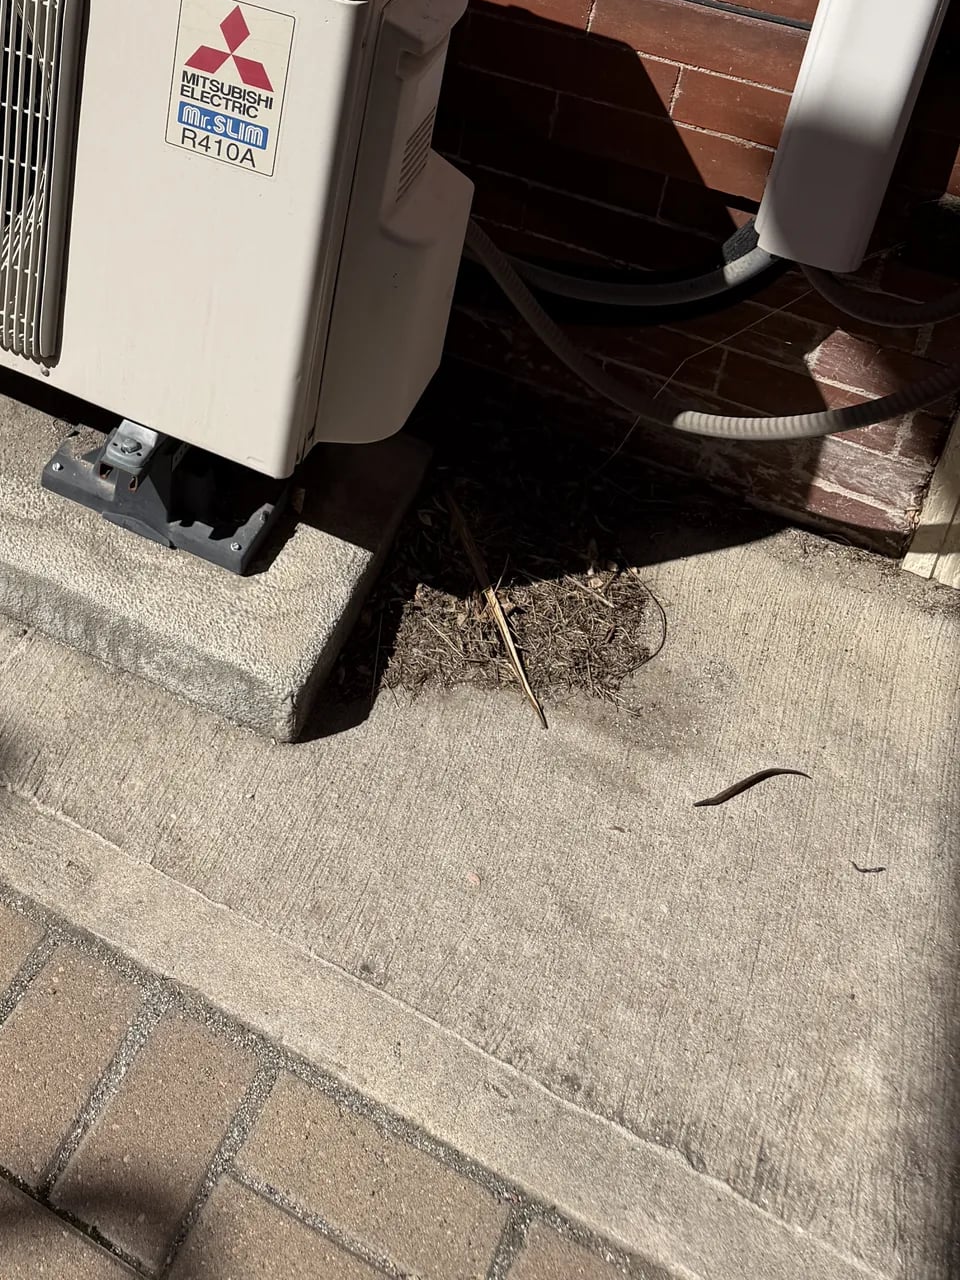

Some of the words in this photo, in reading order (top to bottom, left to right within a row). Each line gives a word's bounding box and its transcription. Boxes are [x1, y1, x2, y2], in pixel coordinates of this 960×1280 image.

[180, 84, 259, 119] ELECTRIC
[181, 70, 274, 110] MITSUBISHI
[181, 127, 256, 168] R410A
